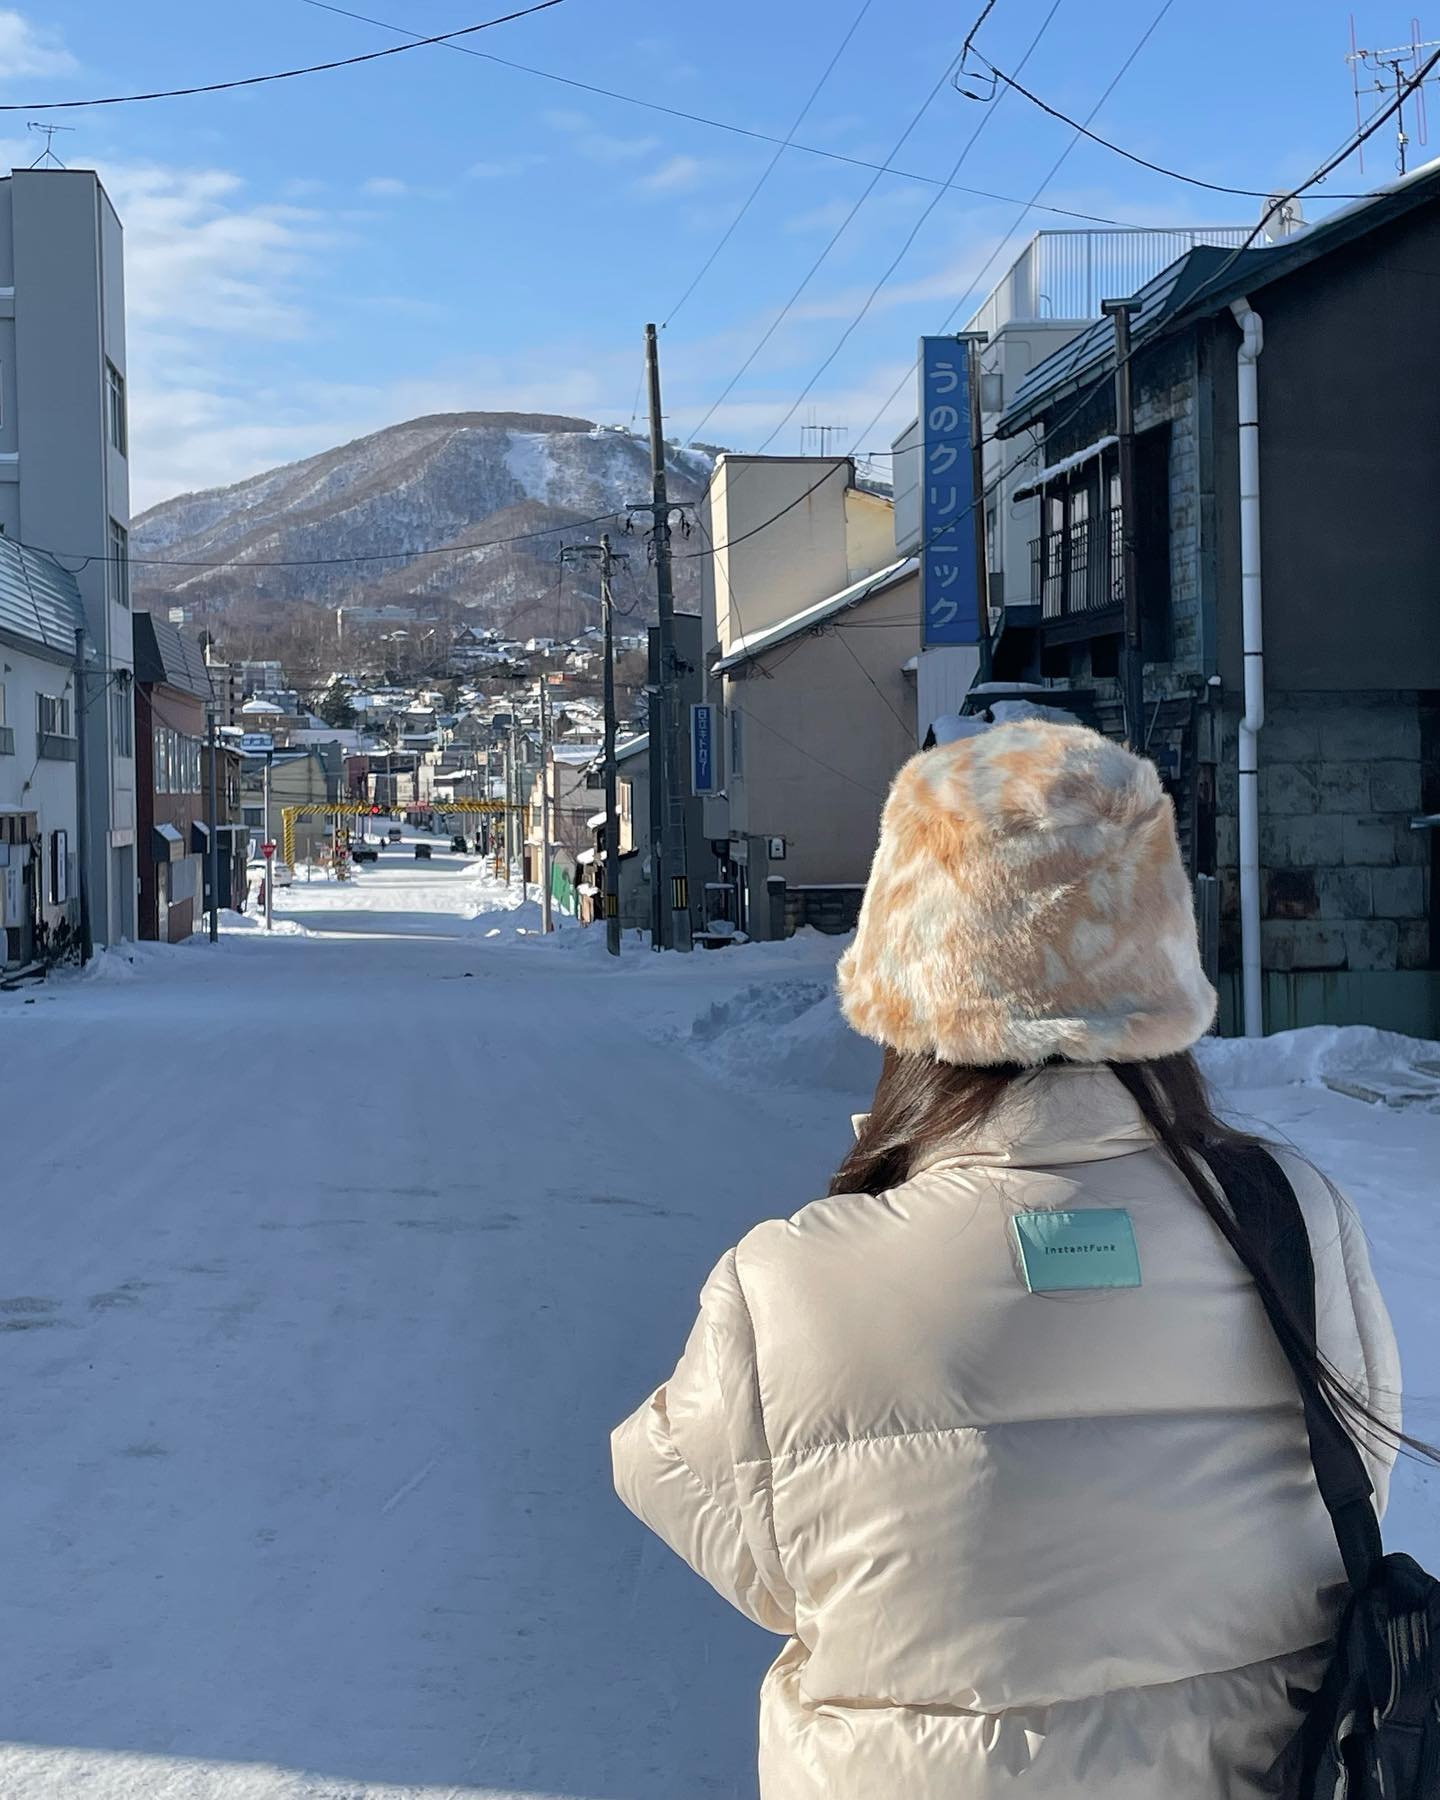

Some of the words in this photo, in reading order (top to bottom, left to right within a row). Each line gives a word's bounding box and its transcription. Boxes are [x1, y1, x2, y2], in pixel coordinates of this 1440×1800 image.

[928, 361, 959, 629] うのクリニック
[1044, 1244, 1116, 1255] InstantFunk
